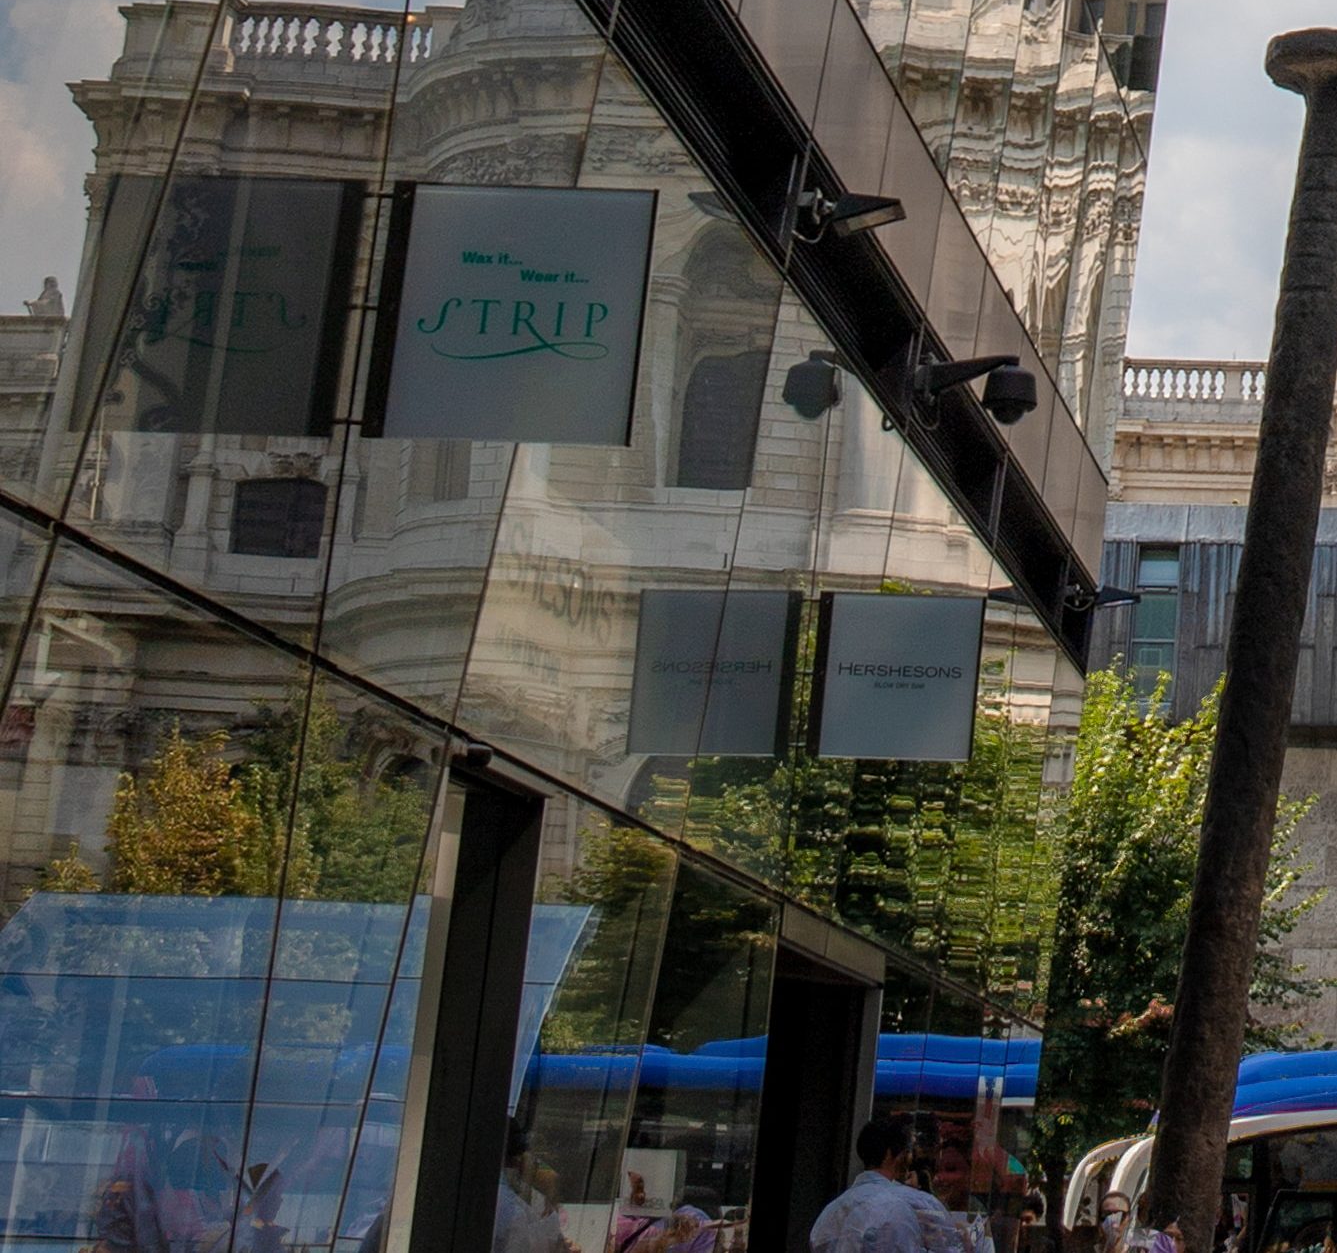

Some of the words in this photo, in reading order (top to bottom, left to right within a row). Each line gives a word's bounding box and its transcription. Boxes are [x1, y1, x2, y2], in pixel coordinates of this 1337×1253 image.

[461, 251, 494, 264] Wax
[519, 269, 560, 283] Wear
[416, 297, 609, 350] STRIP
[838, 662, 962, 679] HERSHESONS
